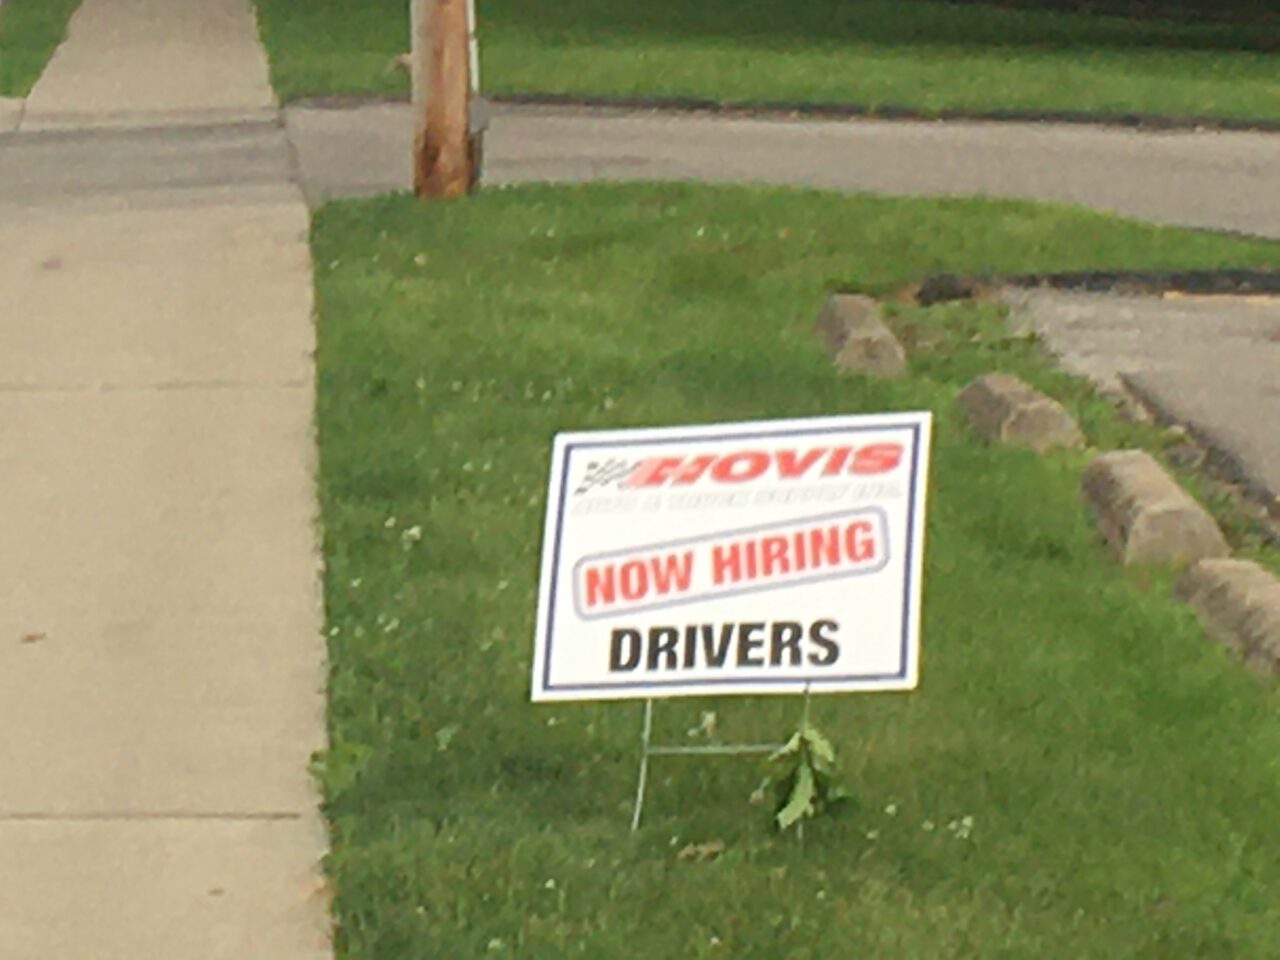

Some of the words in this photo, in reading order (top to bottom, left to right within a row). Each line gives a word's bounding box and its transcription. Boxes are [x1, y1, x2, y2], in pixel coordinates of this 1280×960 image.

[620, 442, 904, 487] HOVIS
[584, 550, 694, 608] NOW
[710, 520, 876, 586] HIRING
[609, 619, 841, 673] DRIVERS
